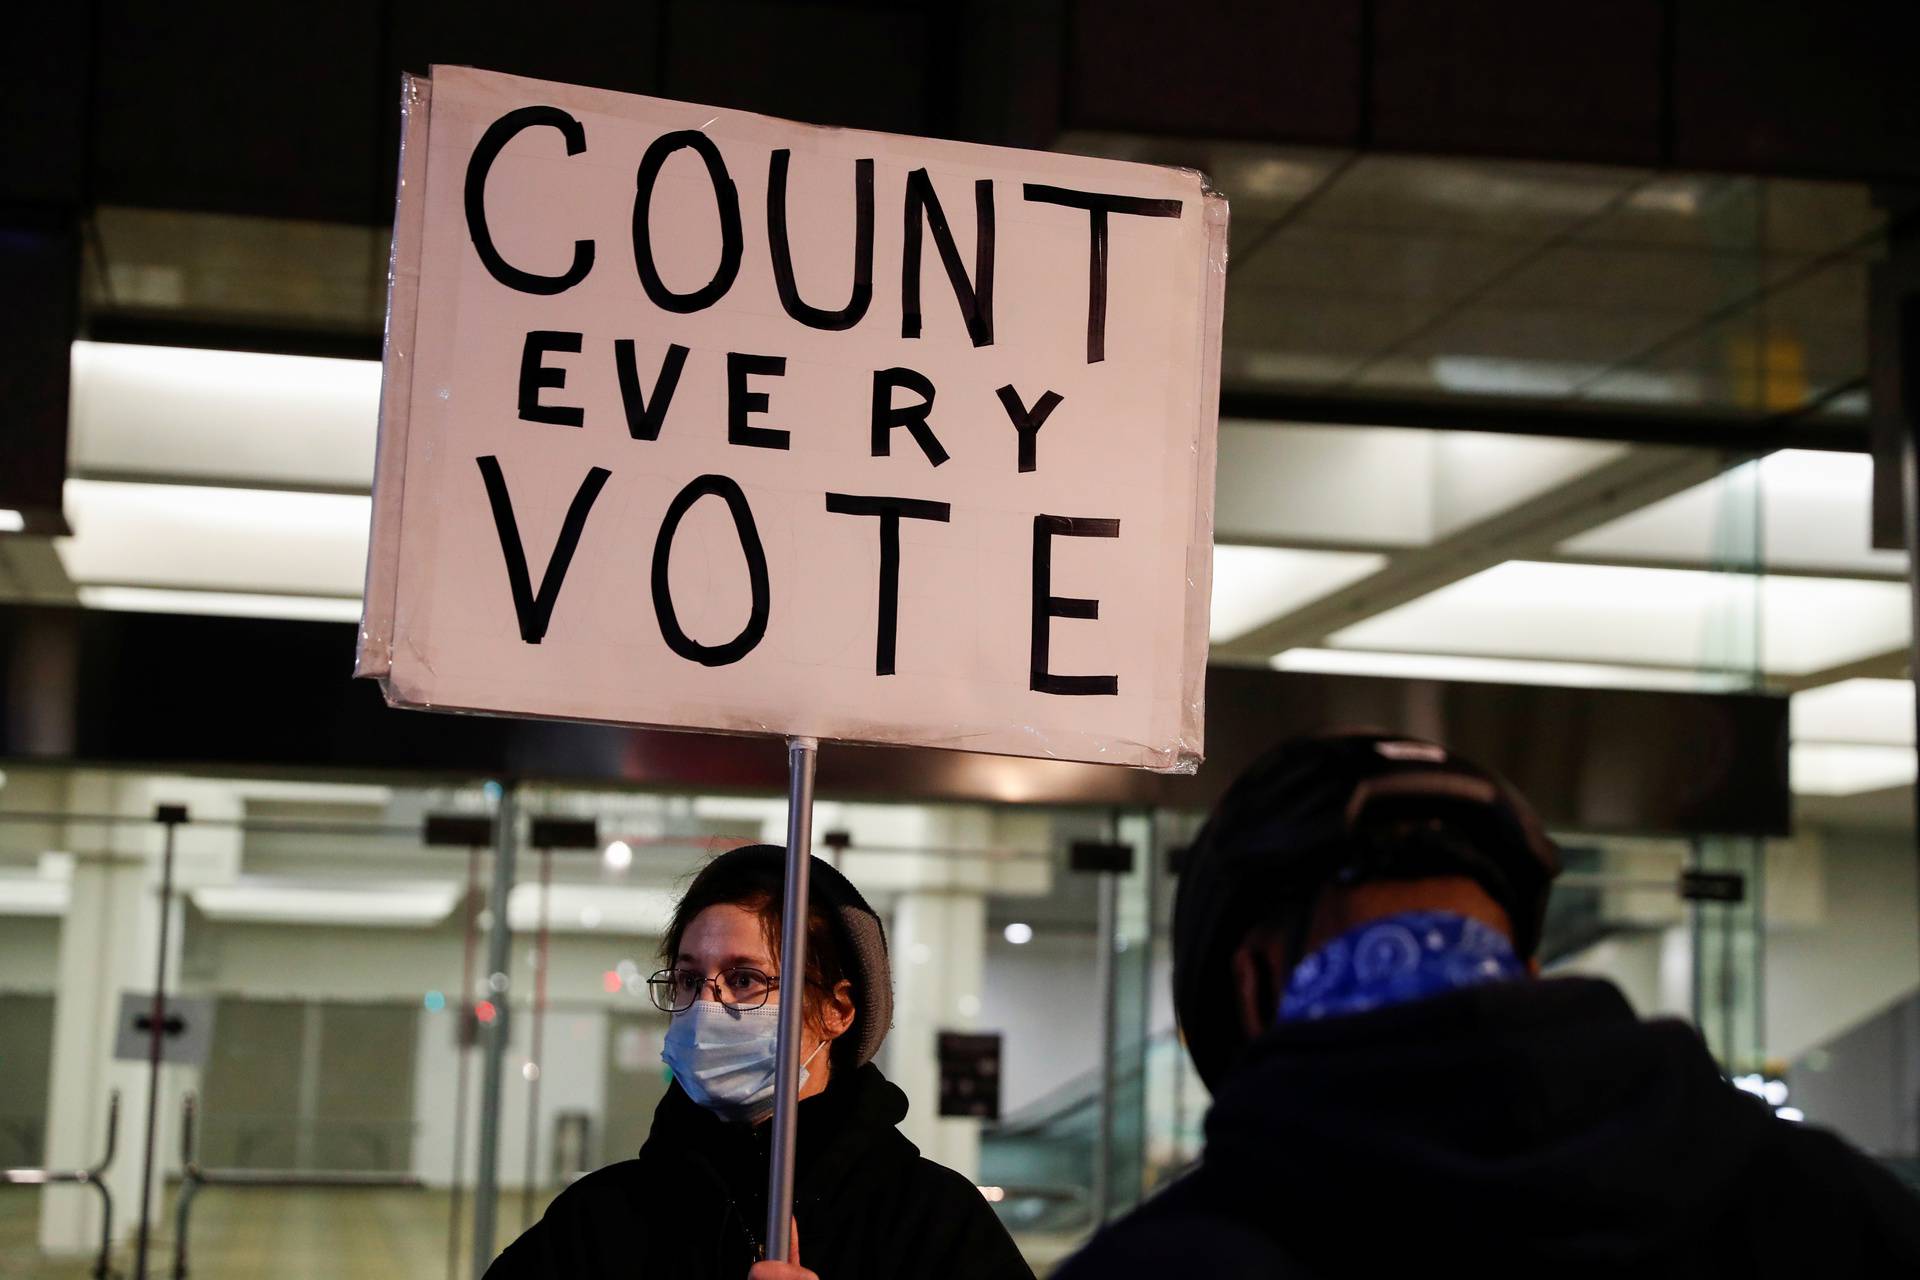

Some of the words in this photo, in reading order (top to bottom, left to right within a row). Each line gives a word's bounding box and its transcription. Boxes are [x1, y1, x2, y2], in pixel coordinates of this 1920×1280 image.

[464, 106, 1183, 364] COUNT
[518, 331, 1064, 473] EVERY
[476, 455, 1120, 695] VOTE
